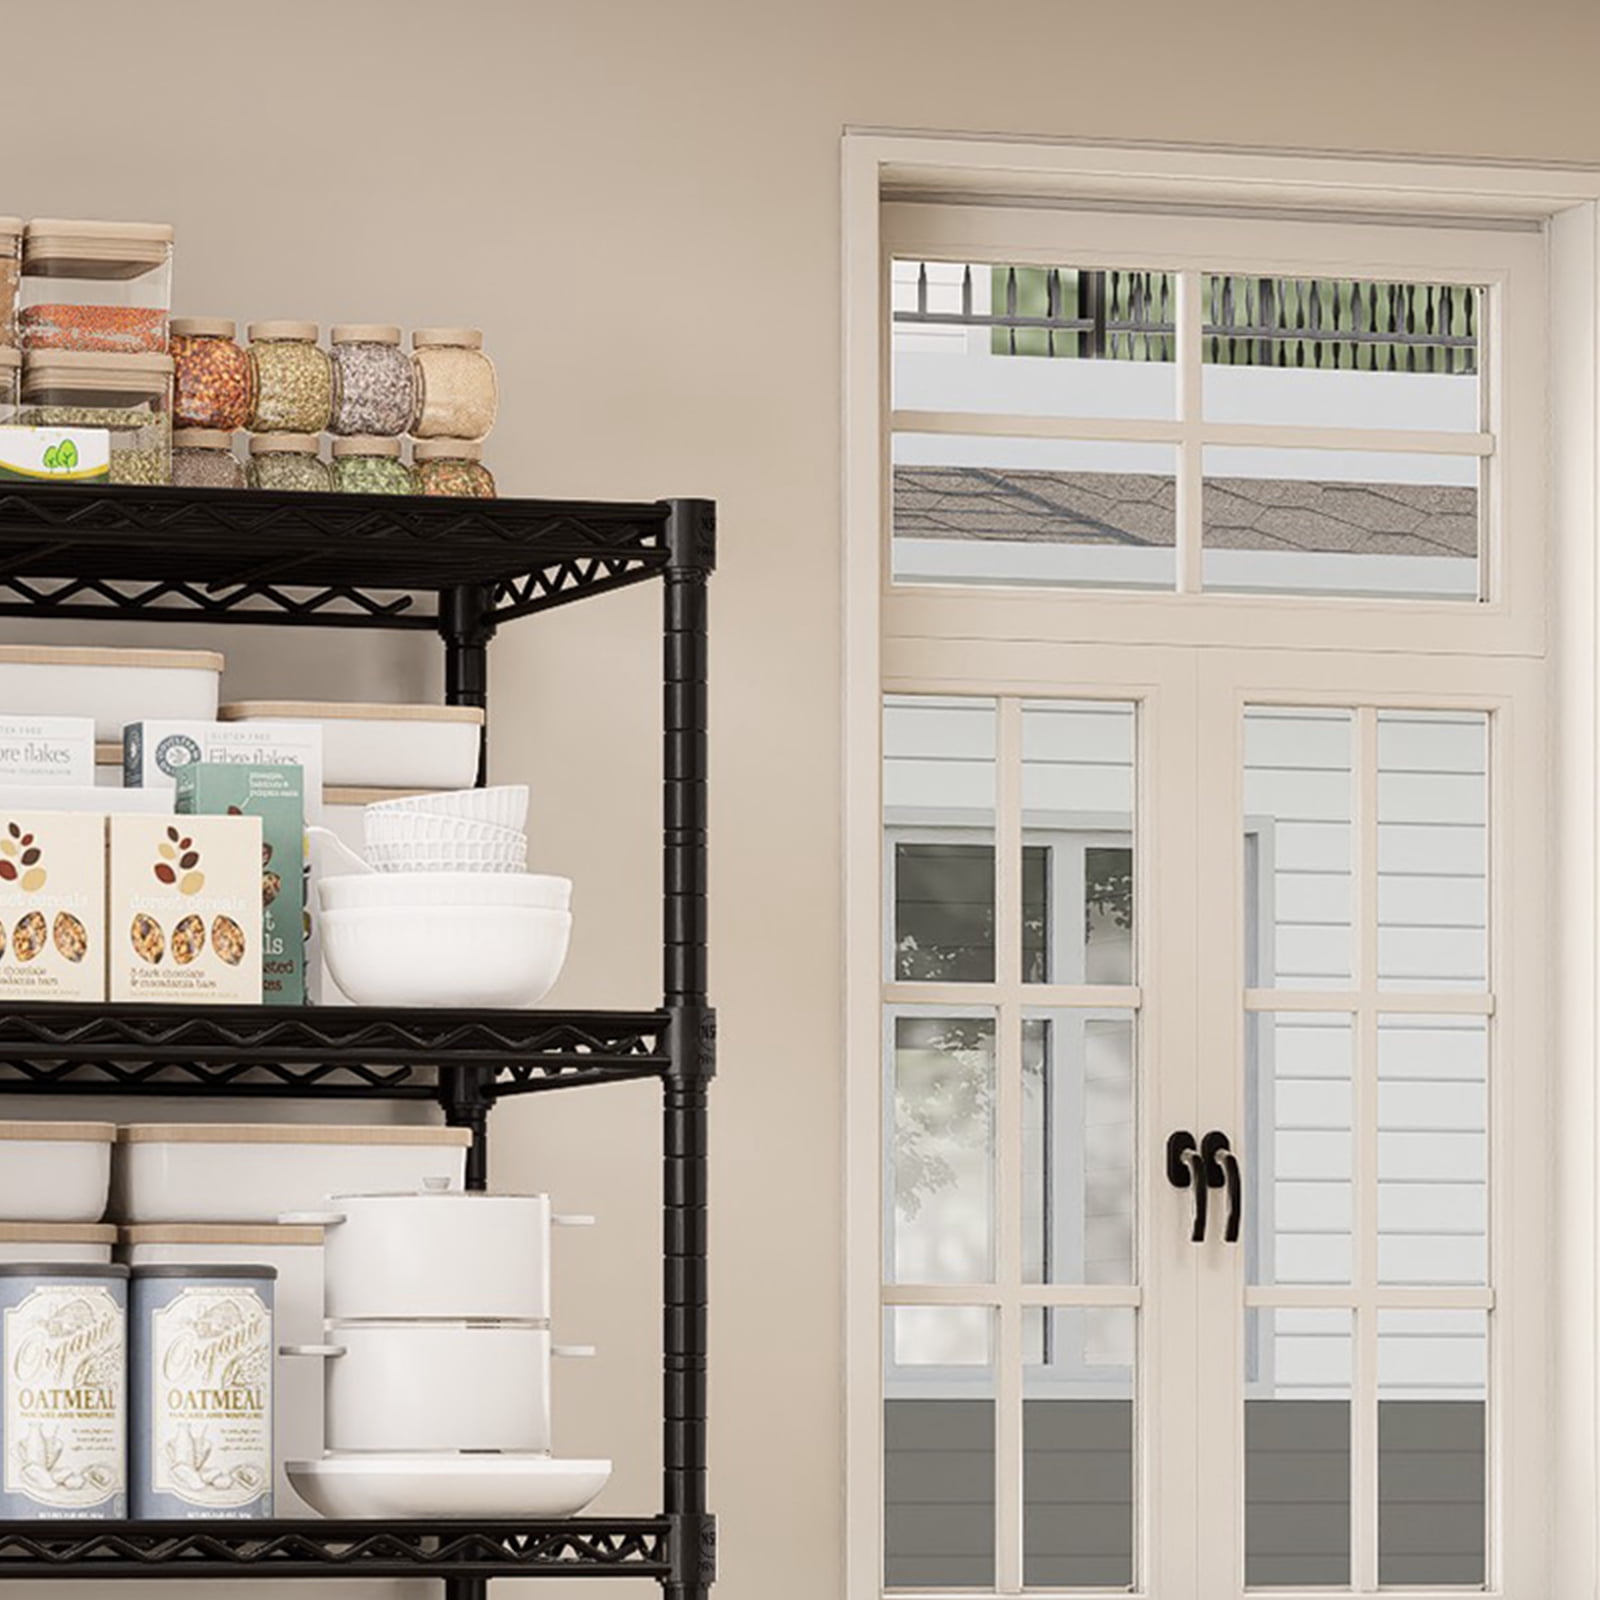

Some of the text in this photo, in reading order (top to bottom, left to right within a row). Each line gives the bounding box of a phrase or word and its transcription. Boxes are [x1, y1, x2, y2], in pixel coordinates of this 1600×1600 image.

[24, 741, 71, 764] flakes
[14, 1312, 113, 1382] Organic
[163, 1313, 261, 1383] Organic
[19, 1388, 116, 1410] OATMEAL
[168, 1389, 264, 1411] OATMEAL
